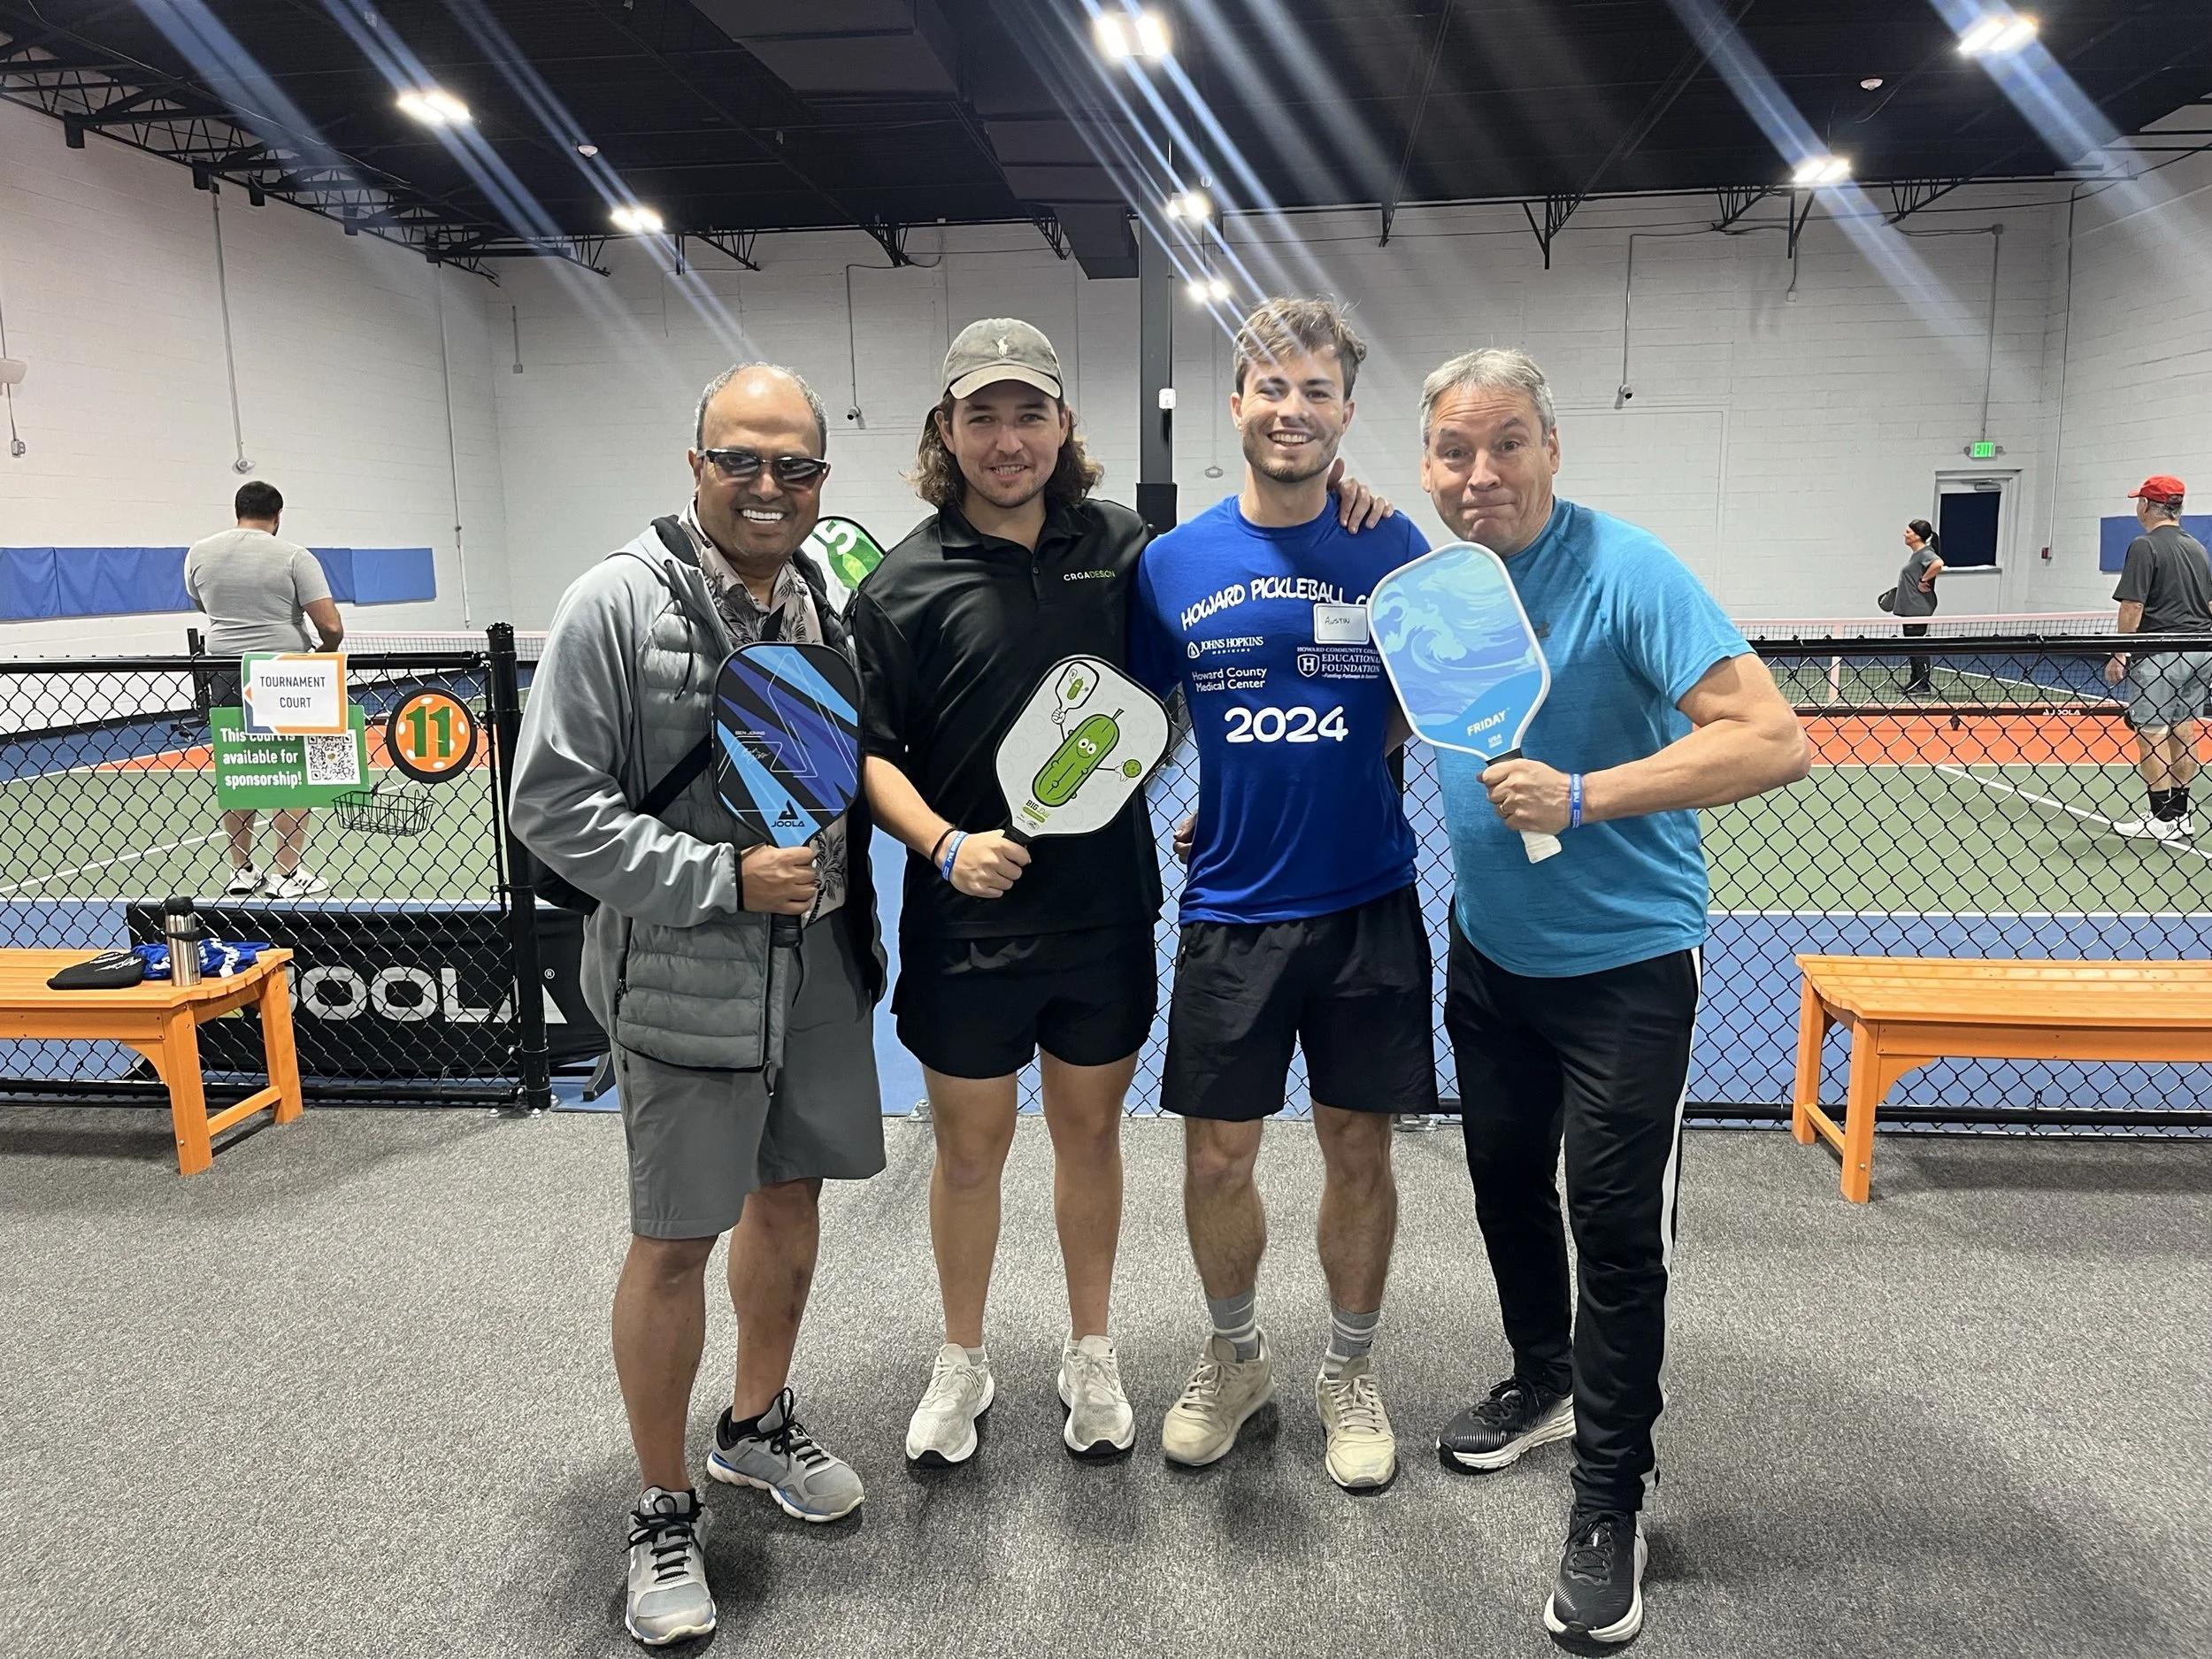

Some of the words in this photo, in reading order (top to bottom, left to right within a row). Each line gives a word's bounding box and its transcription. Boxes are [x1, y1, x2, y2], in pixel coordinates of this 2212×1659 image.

[1180, 584, 1246, 631] HOWARD
[1250, 576, 1348, 604] PICKLEBALL
[1200, 638, 1225, 653] JOHNS
[1225, 636, 1263, 648] HOPKINS
[1192, 668, 1224, 681] Howard
[1226, 667, 1267, 679] County
[1321, 664, 1380, 672] FOUNDATION
[260, 676, 326, 687] TOURNAMENT
[1195, 680, 1225, 692] Medical
[1227, 679, 1265, 689] Center
[280, 697, 311, 708] COURT
[1225, 706, 1348, 743] 2024
[1467, 710, 1506, 736] FRIDAY
[219, 728, 247, 743] This
[406, 706, 450, 757] 11
[223, 749, 278, 765] available
[280, 749, 298, 764] for
[225, 771, 303, 790] sponsorship!
[1025, 799, 1040, 811] BIG
[257, 965, 568, 1024] OOLA
